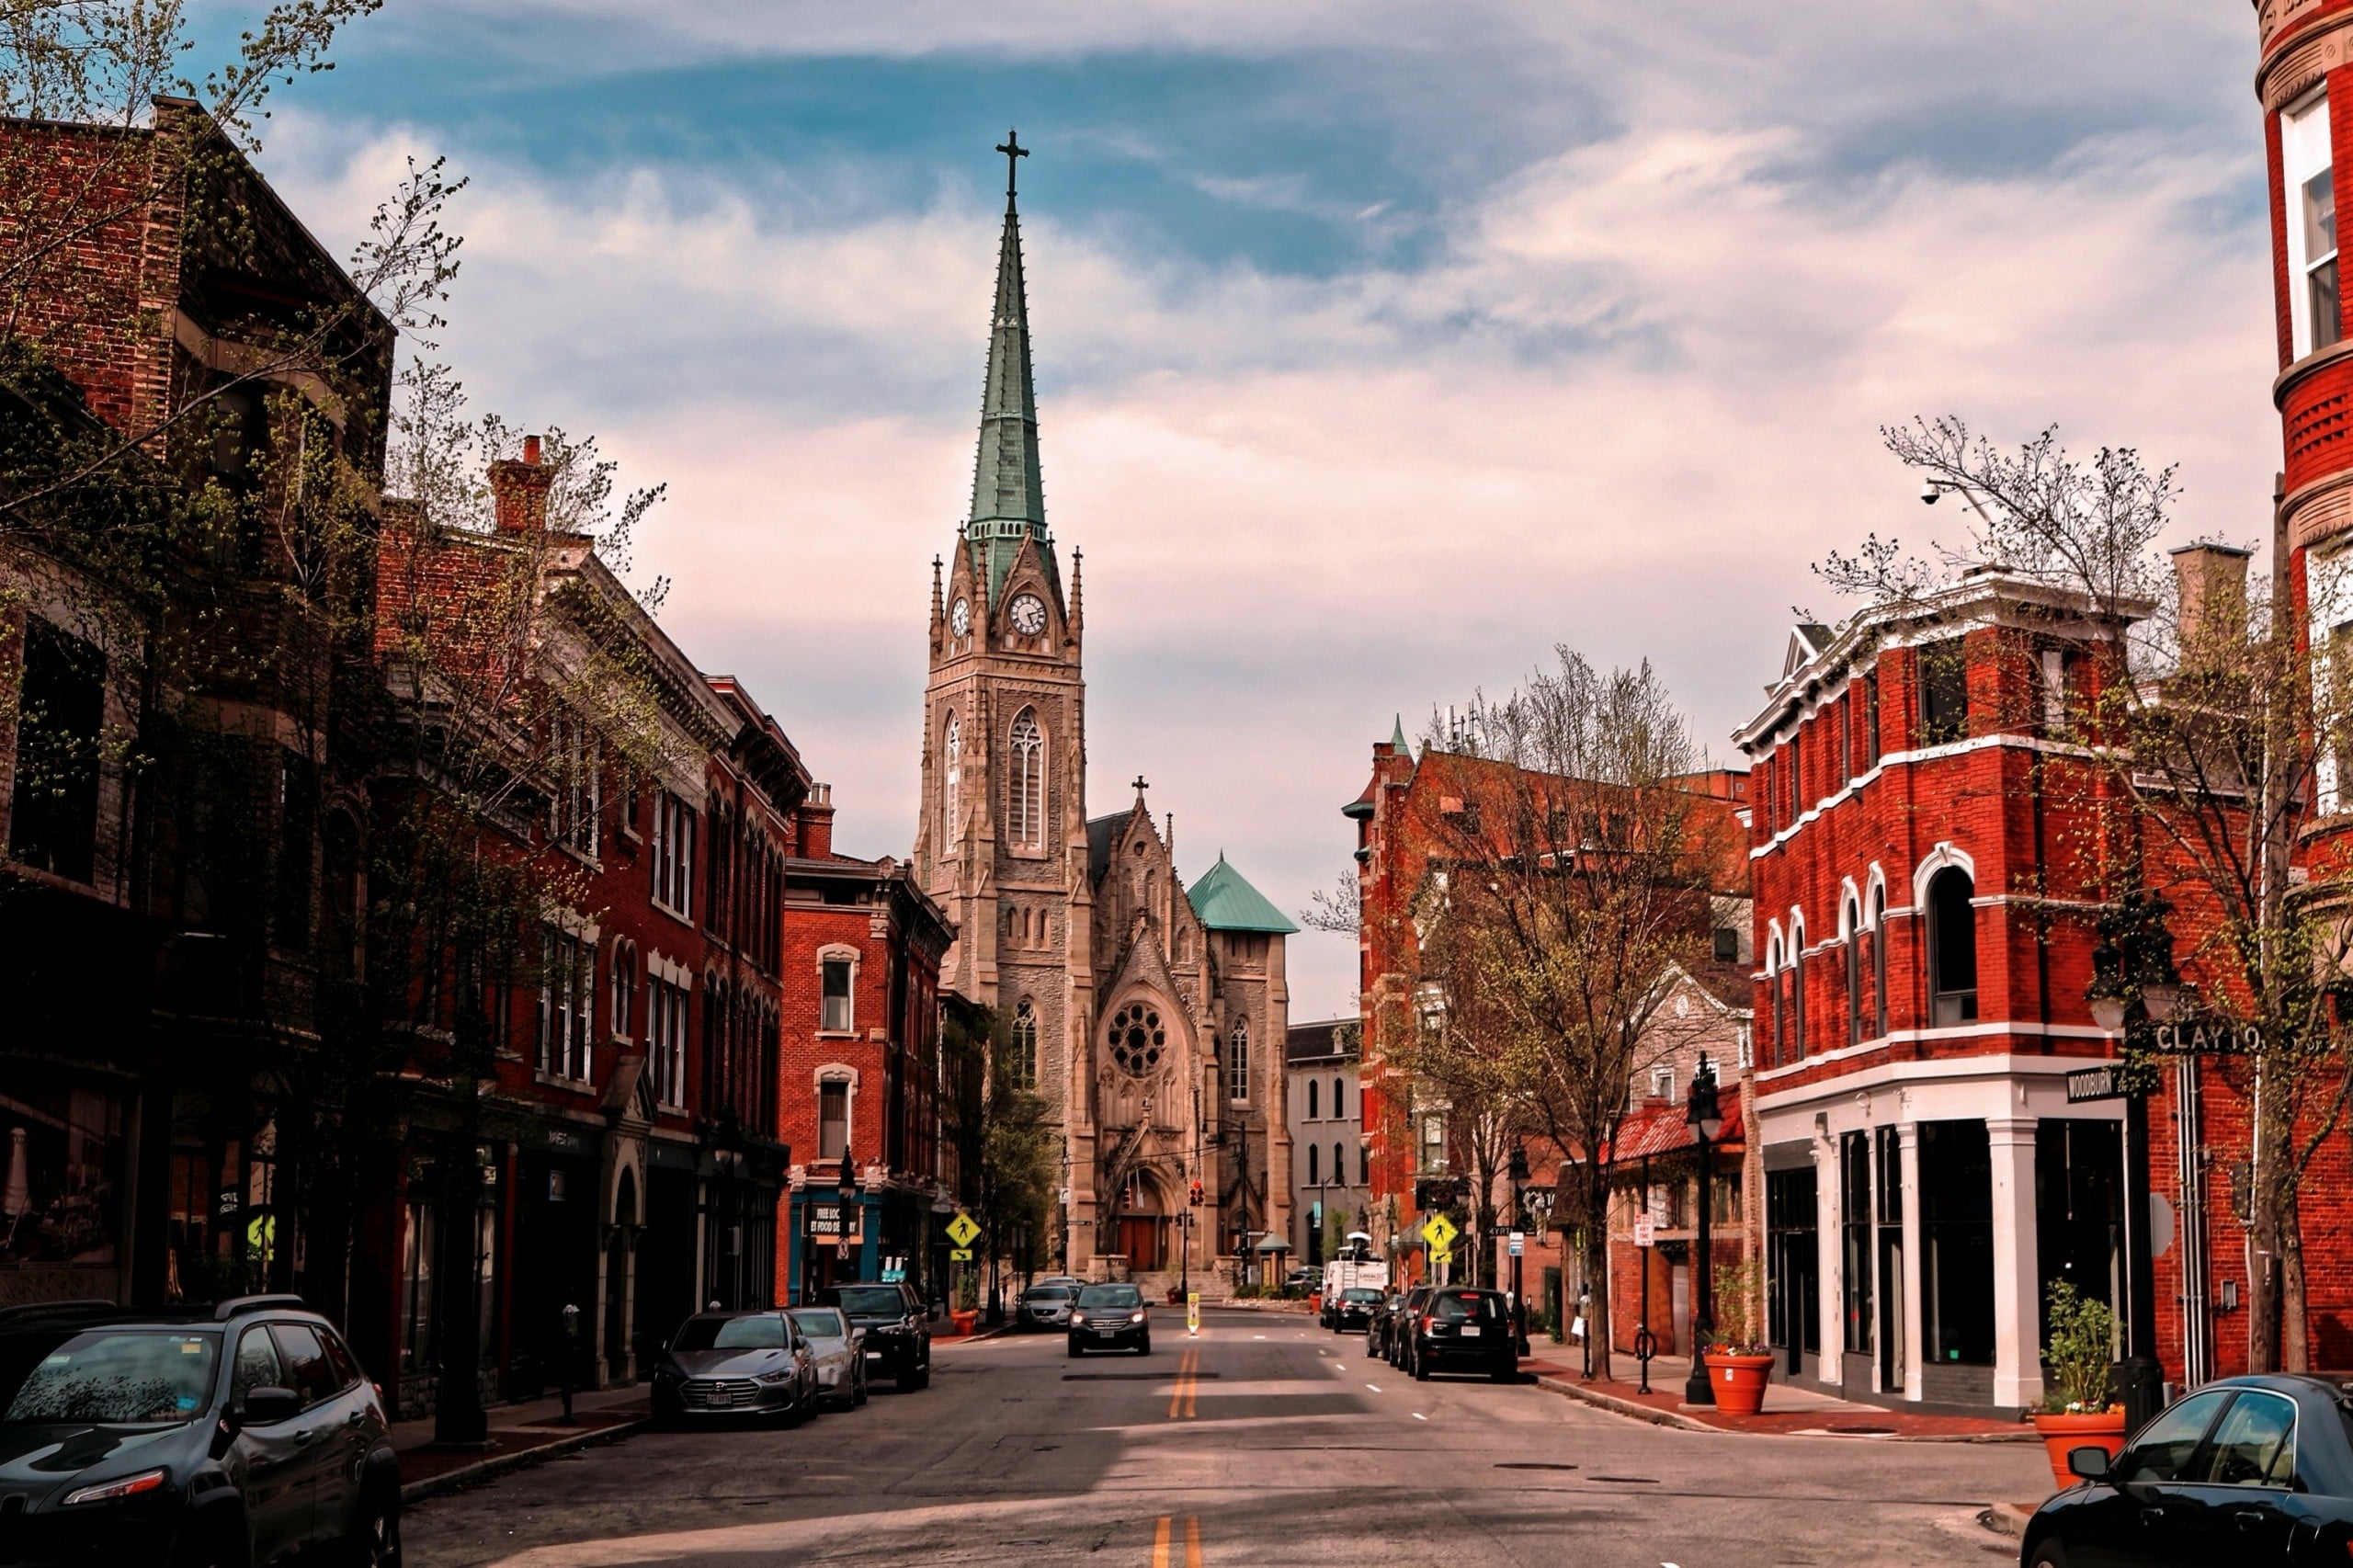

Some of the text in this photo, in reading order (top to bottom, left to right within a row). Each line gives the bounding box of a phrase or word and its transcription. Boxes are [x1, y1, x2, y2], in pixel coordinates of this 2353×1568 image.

[2068, 1069, 2112, 1098] WOODBURN
[816, 1208, 840, 1220] FREE LOC
[817, 1221, 833, 1233] FOOD
